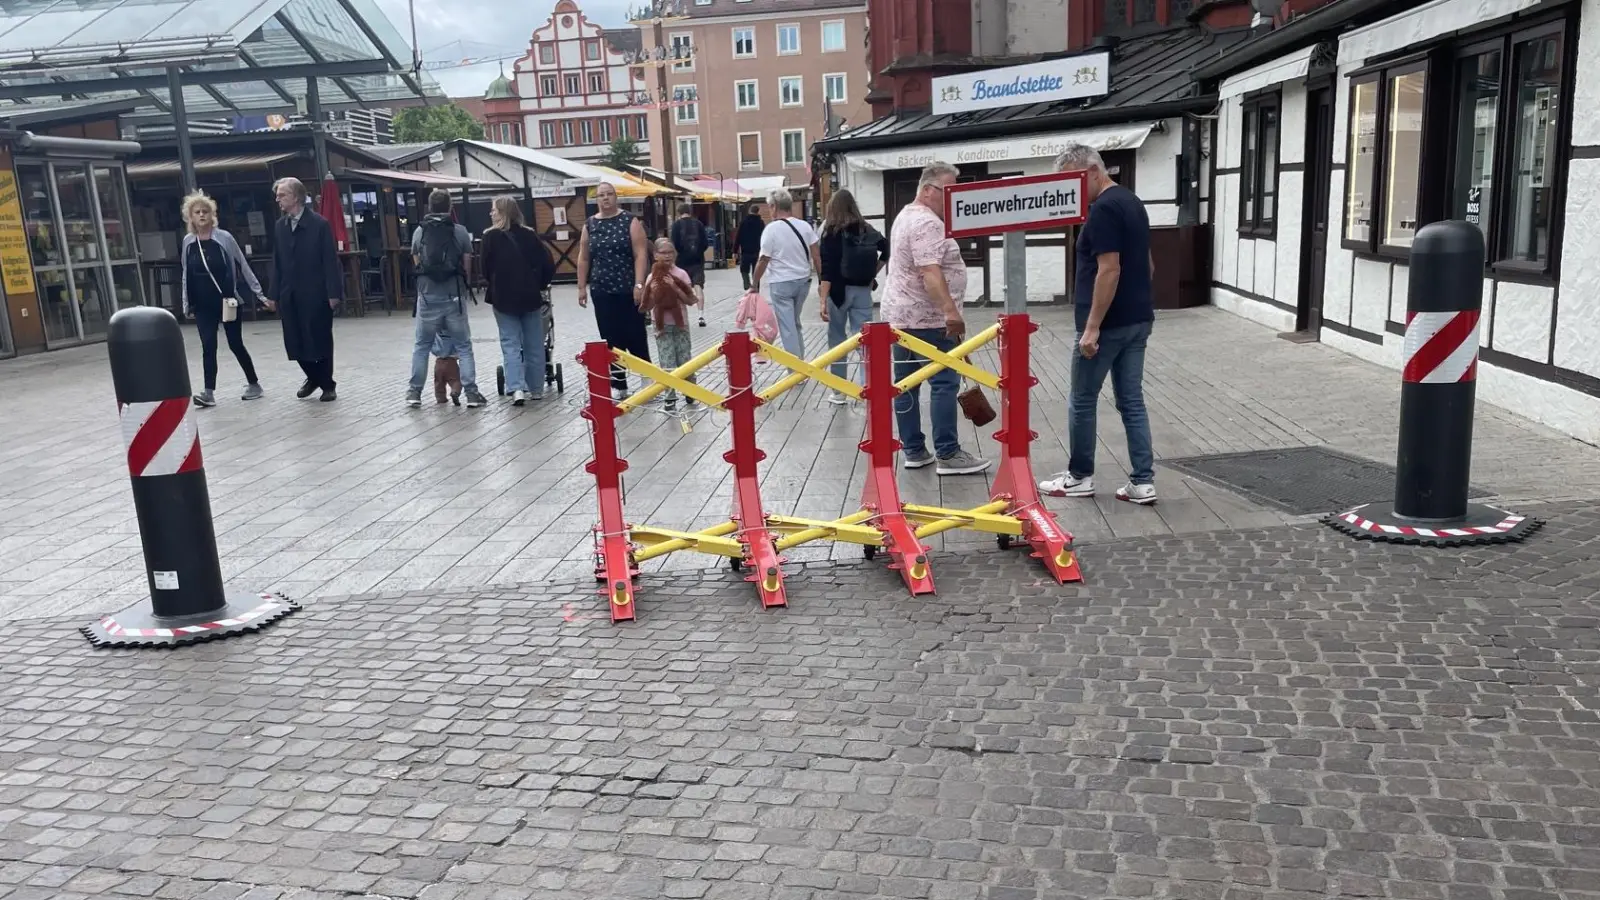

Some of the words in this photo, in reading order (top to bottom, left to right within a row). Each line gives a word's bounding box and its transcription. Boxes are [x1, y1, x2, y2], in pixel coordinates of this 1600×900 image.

[971, 74, 1063, 101] Brandstetter
[898, 152, 936, 168] Bäckerei
[957, 146, 1009, 162] Konditorei
[956, 188, 1076, 217] Feuerwehrzufahrt
[1466, 202, 1479, 213] BOSS
